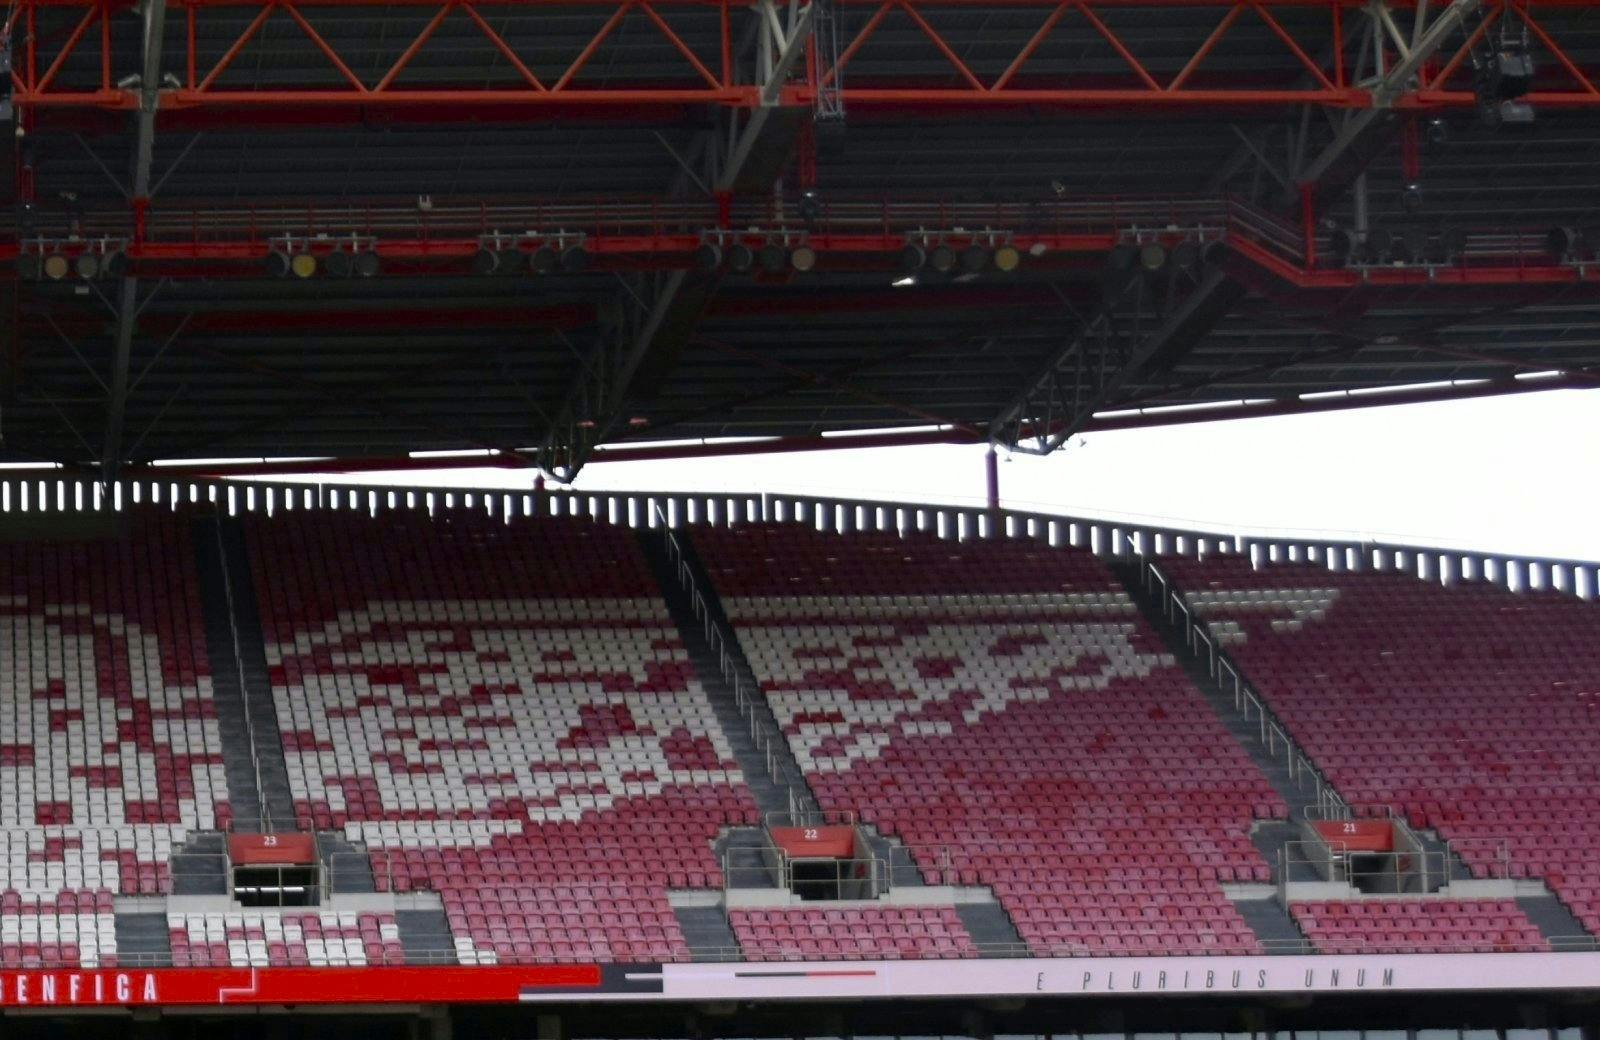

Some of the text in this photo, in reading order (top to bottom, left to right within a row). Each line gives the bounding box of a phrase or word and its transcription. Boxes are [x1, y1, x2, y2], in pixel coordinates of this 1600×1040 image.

[1343, 821, 1357, 833] 21
[804, 828, 819, 840] 22
[263, 835, 278, 847] 23
[1035, 968, 1394, 991] E PLURIBUS UNUM
